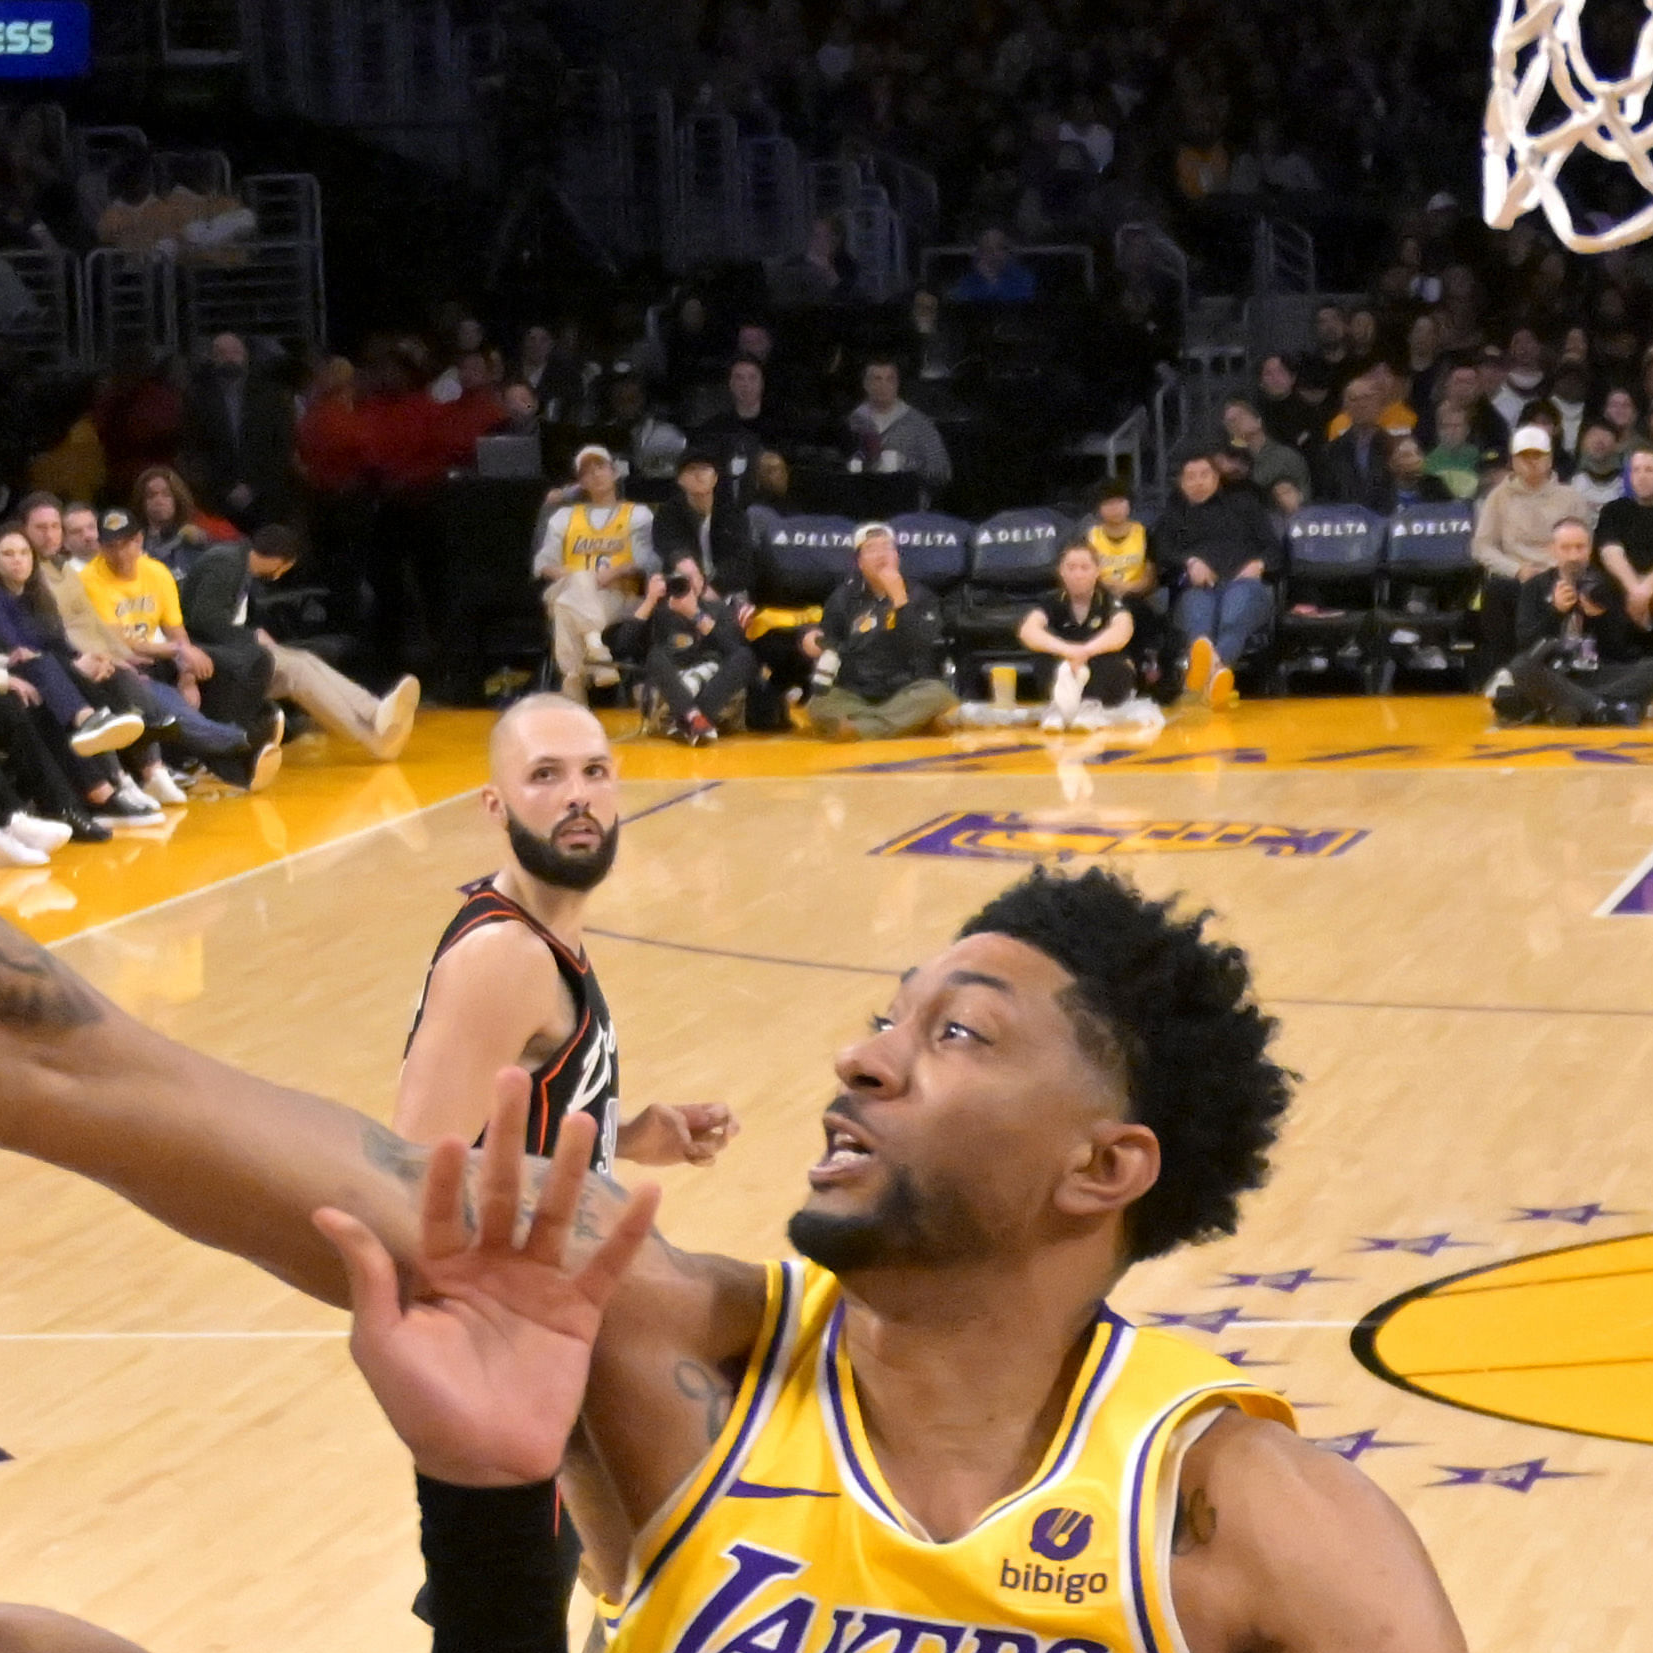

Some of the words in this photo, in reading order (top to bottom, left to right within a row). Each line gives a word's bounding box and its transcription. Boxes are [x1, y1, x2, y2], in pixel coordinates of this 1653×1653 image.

[998, 526, 1056, 543] DELTA
[1308, 522, 1368, 537] DELTA
[1412, 519, 1473, 535] DELTA
[794, 532, 853, 547] DELTA
[898, 532, 957, 547] DELTA
[1000, 1558, 1109, 1604] bibigo
